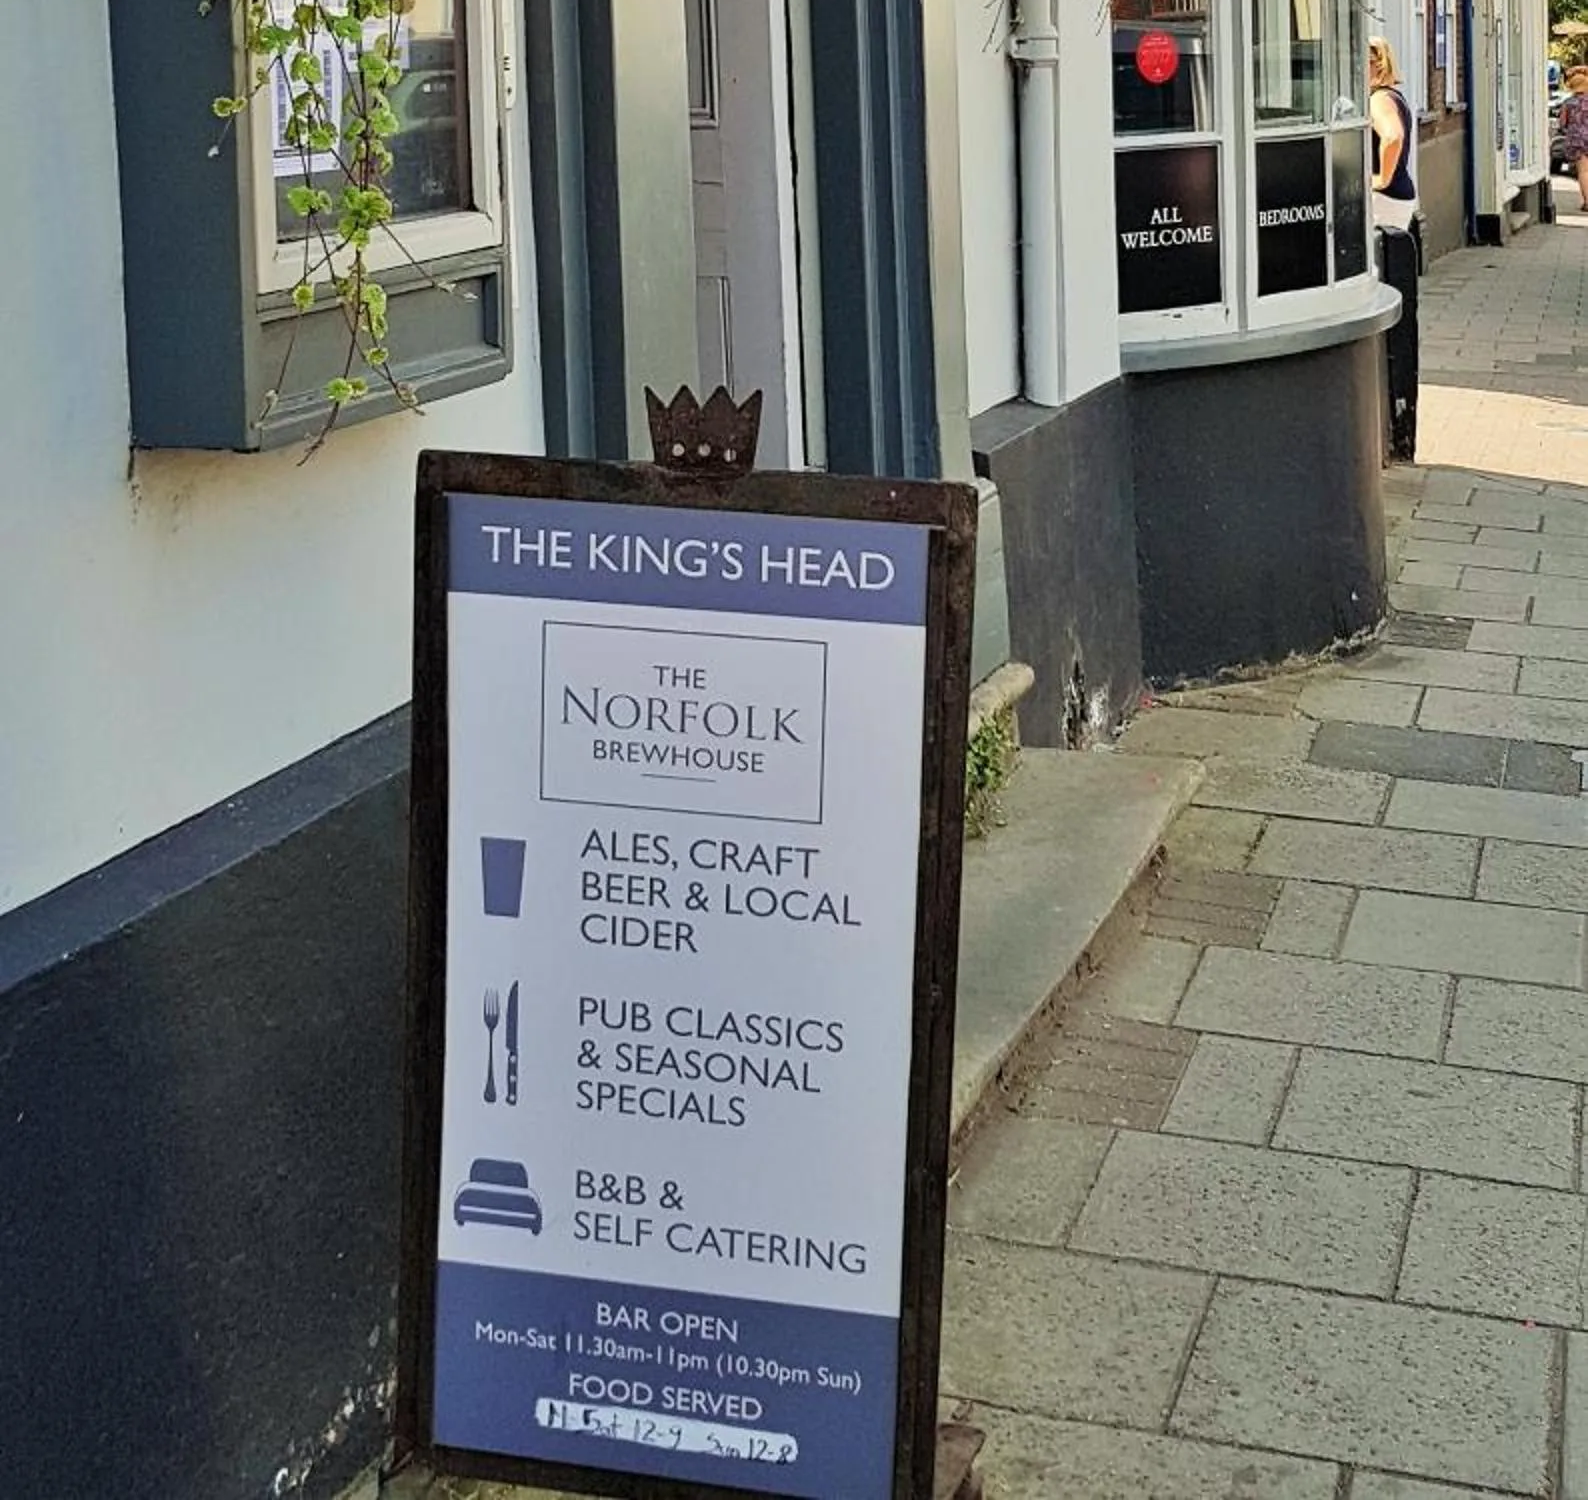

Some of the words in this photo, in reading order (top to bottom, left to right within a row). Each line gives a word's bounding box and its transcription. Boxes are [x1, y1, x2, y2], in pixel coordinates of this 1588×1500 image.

[1120, 226, 1213, 249] WELCOME
[1151, 207, 1183, 224] ALL
[1259, 204, 1325, 227] BEDROOMS
[481, 525, 573, 569] THE
[588, 533, 744, 581] KING'S
[761, 545, 895, 591] HEAD
[653, 665, 706, 689] THE
[561, 685, 804, 743] NORFOLK
[593, 739, 764, 774] BREWHOUSE
[581, 829, 678, 870] ALES,
[689, 839, 819, 878] CRAFT
[582, 872, 671, 909] BEER
[685, 882, 709, 911] &
[725, 884, 862, 926] LOCAL
[581, 914, 698, 952] CIDER
[579, 997, 652, 1032] PUB
[666, 1007, 844, 1052] CLASSICS
[577, 1040, 601, 1069] &
[615, 1043, 820, 1093] SEASONAL
[576, 1081, 746, 1127] SPECIALS
[576, 1170, 646, 1205] B&B
[660, 1180, 684, 1209] &
[574, 1212, 653, 1248] SELF
[666, 1223, 867, 1274] CATERING
[596, 1303, 650, 1331] BAR
[661, 1311, 738, 1343] OPEN
[475, 1322, 556, 1351] Mon-Sat
[565, 1334, 708, 1372] 11.30am-11pm
[717, 1352, 811, 1385] (10.30pm
[817, 1370, 862, 1395] Sun)
[569, 1373, 652, 1404] FOOD
[662, 1389, 762, 1421] SERVED
[634, 1418, 682, 1449] 12-9
[749, 1437, 792, 1465] 12-8
